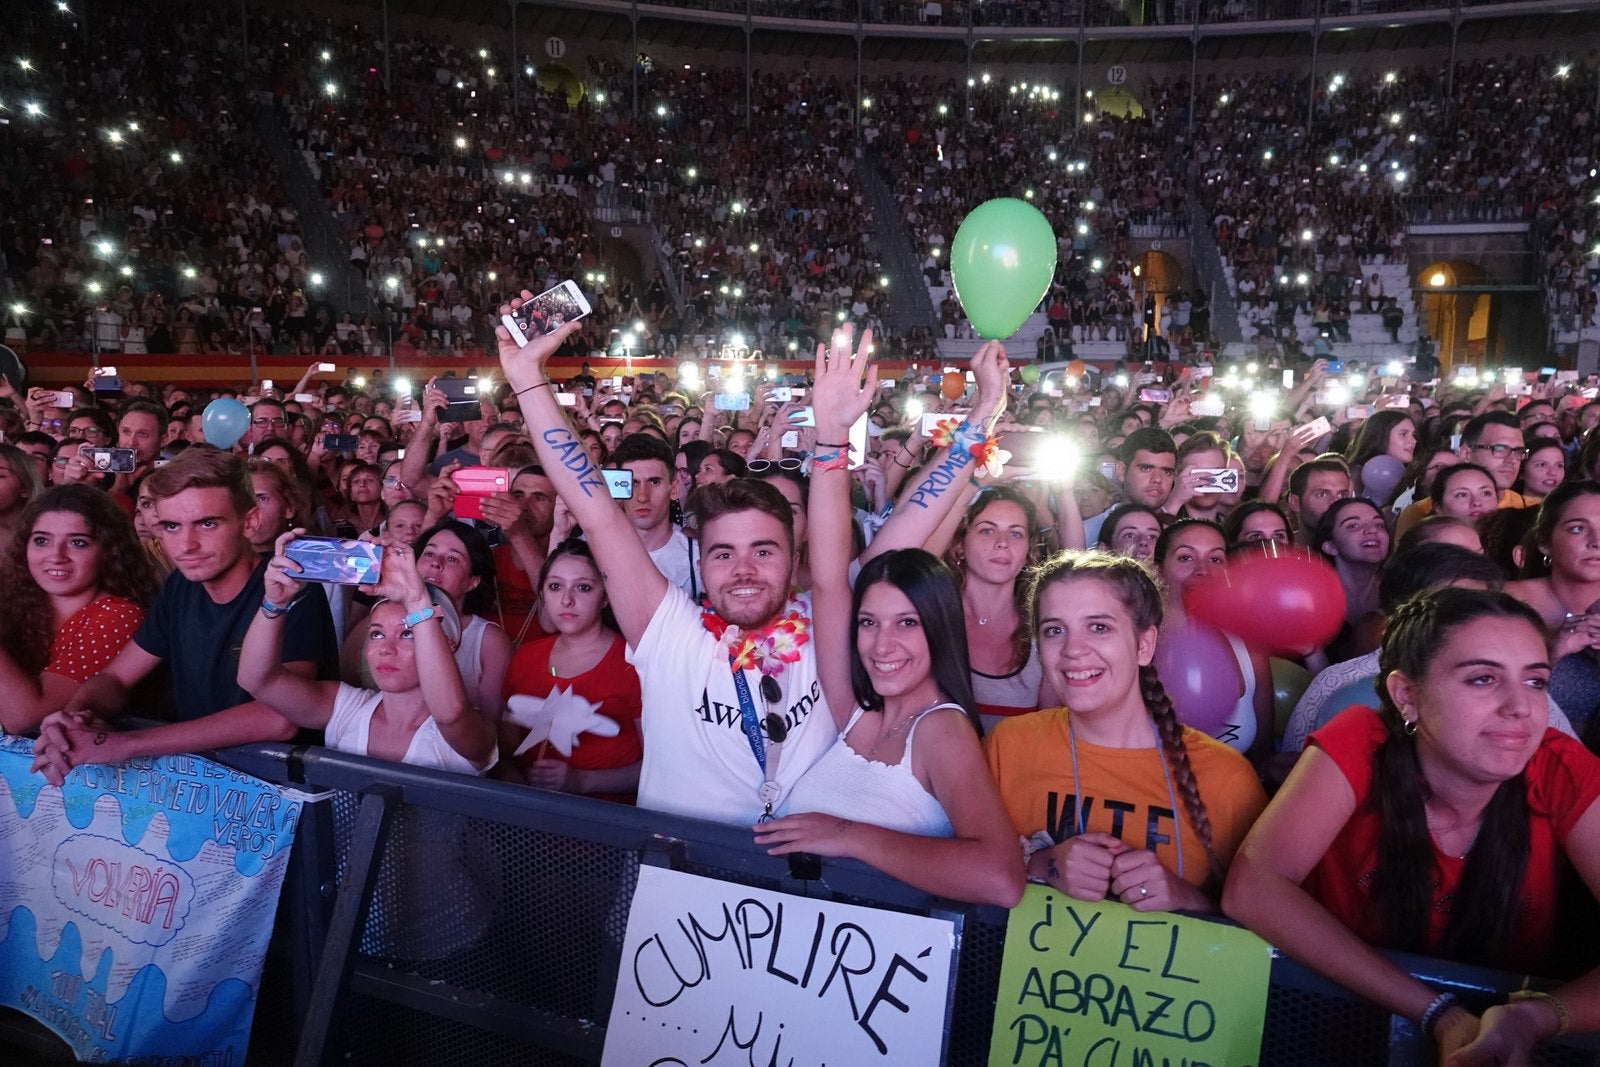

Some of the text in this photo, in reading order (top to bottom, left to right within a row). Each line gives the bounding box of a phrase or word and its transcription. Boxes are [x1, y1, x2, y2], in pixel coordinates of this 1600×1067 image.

[1111, 67, 1123, 82] 12
[135, 770, 210, 815] PROMETO
[213, 785, 281, 830] VOLVER
[282, 802, 300, 835] A
[1046, 791, 1177, 851] WTF
[213, 819, 278, 860] VEROS
[1029, 895, 1200, 983] ¿Y EL
[634, 898, 932, 1055] CUMPLIRÉ
[1017, 967, 1215, 1043] ABRAZO
